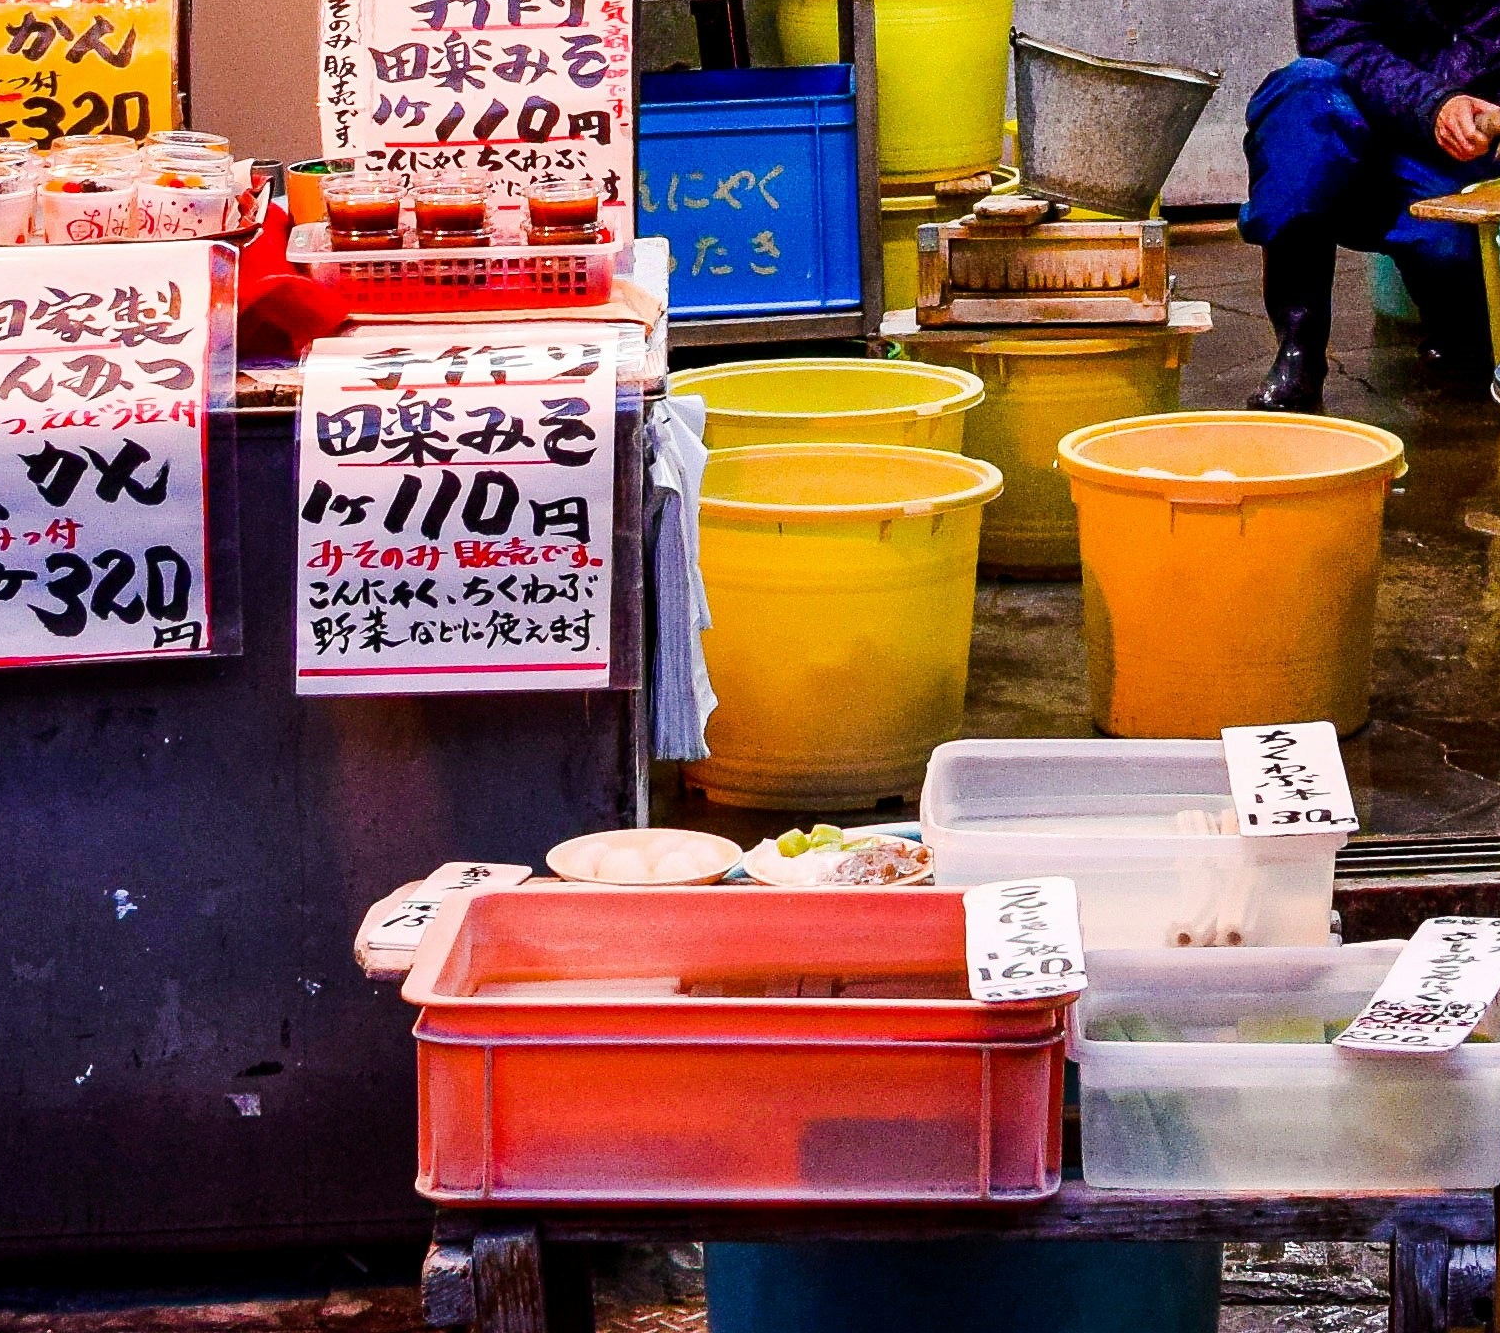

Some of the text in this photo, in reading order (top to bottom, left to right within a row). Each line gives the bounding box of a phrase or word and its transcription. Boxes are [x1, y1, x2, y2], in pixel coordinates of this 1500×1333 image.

[368, 32, 611, 92] 田楽みそ
[435, 95, 612, 146] 110円
[356, 344, 601, 389] 手作り
[315, 390, 599, 467] 田楽みそ
[383, 470, 592, 544] 110円
[27, 544, 202, 650] 320円
